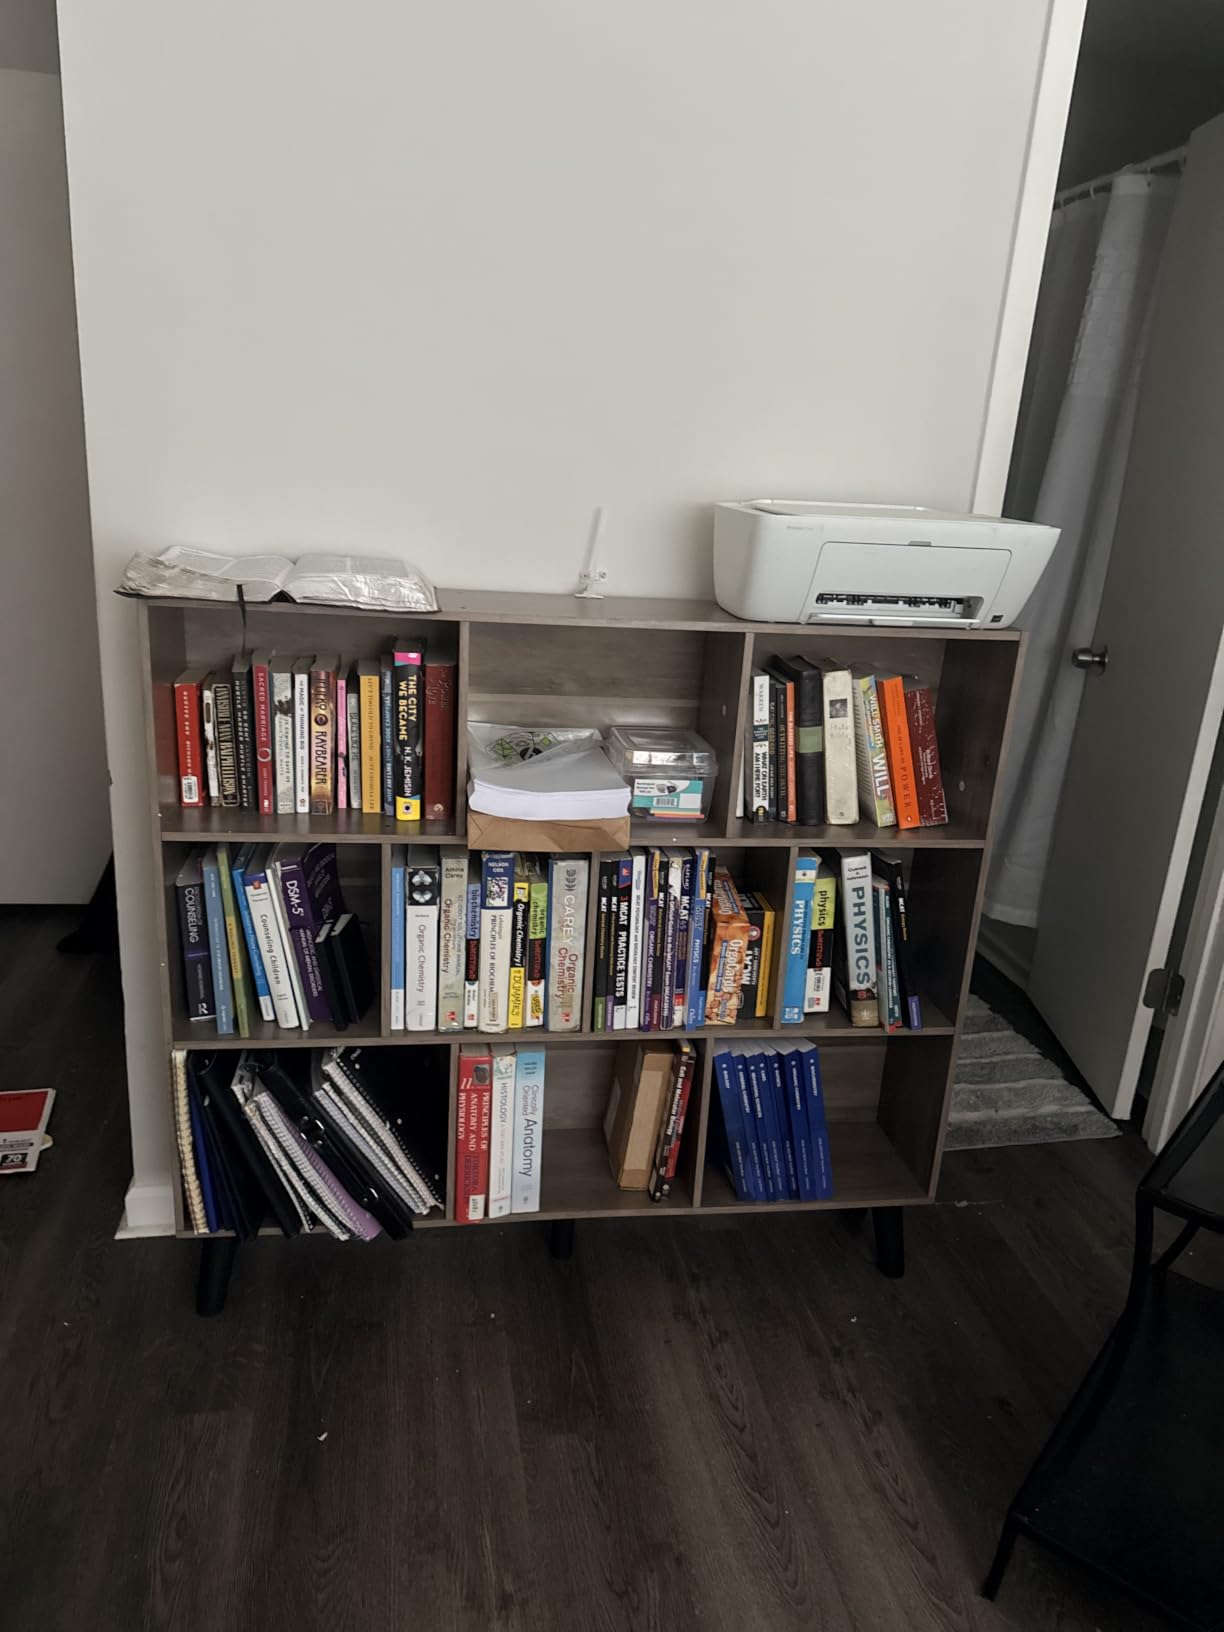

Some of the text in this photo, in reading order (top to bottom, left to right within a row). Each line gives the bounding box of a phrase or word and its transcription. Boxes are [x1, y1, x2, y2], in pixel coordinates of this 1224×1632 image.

[215, 688, 232, 740] INVISIBLE MAN
[258, 672, 267, 742] SACRED MARRIAGE
[398, 681, 408, 741] WE BECAME
[408, 675, 417, 722] THE CITY
[869, 695, 878, 716] WILL
[872, 719, 882, 748] SMITH
[220, 742, 235, 794] RALPH ELLISON
[315, 731, 328, 785] RAYBEARER
[404, 747, 412, 796] N. K. JEMISIN
[754, 752, 760, 763] AM
[762, 771, 768, 780] ON
[872, 753, 890, 796] WILL
[900, 766, 911, 808] POWER
[184, 888, 198, 943] COUNSELING
[456, 895, 464, 920] STUDENT
[470, 889, 479, 938] biochemistry
[515, 903, 524, 929] Organic
[531, 901, 539, 935] chemistry
[563, 895, 576, 945] CAREY
[619, 902, 628, 925] MCAT
[679, 896, 690, 920] MCAT
[791, 900, 805, 955] PHYSICS
[817, 890, 829, 927] physics
[260, 914, 281, 985] Counseling Children
[442, 899, 453, 974] Organic Chemistry
[489, 915, 498, 961] PRINCIPLES OF
[514, 930, 524, 963] Chemistry
[616, 931, 627, 971] PRACTICE
[852, 886, 870, 985] PHYSICS
[304, 955, 313, 972] MENTAL
[415, 924, 426, 992] Organic Chemistry
[555, 948, 568, 999] Chemistry
[566, 953, 578, 992] Organic
[723, 939, 743, 992] OrgoCards
[511, 976, 522, 1016] DUMMIES
[616, 972, 627, 997] TESTS
[676, 1078, 685, 1088] and
[678, 1066, 686, 1077] Cell
[458, 1093, 467, 1140] PHYSIOLOGY
[469, 1093, 478, 1131] ANATOMY
[500, 1082, 508, 1123] HISTOLOGY
[522, 1085, 531, 1116] Oriented
[530, 1085, 540, 1116] Clinically
[671, 1088, 682, 1115] Molecular
[481, 1092, 489, 1151] PRINCIPLES OF
[518, 1118, 538, 1177] Anatomy
